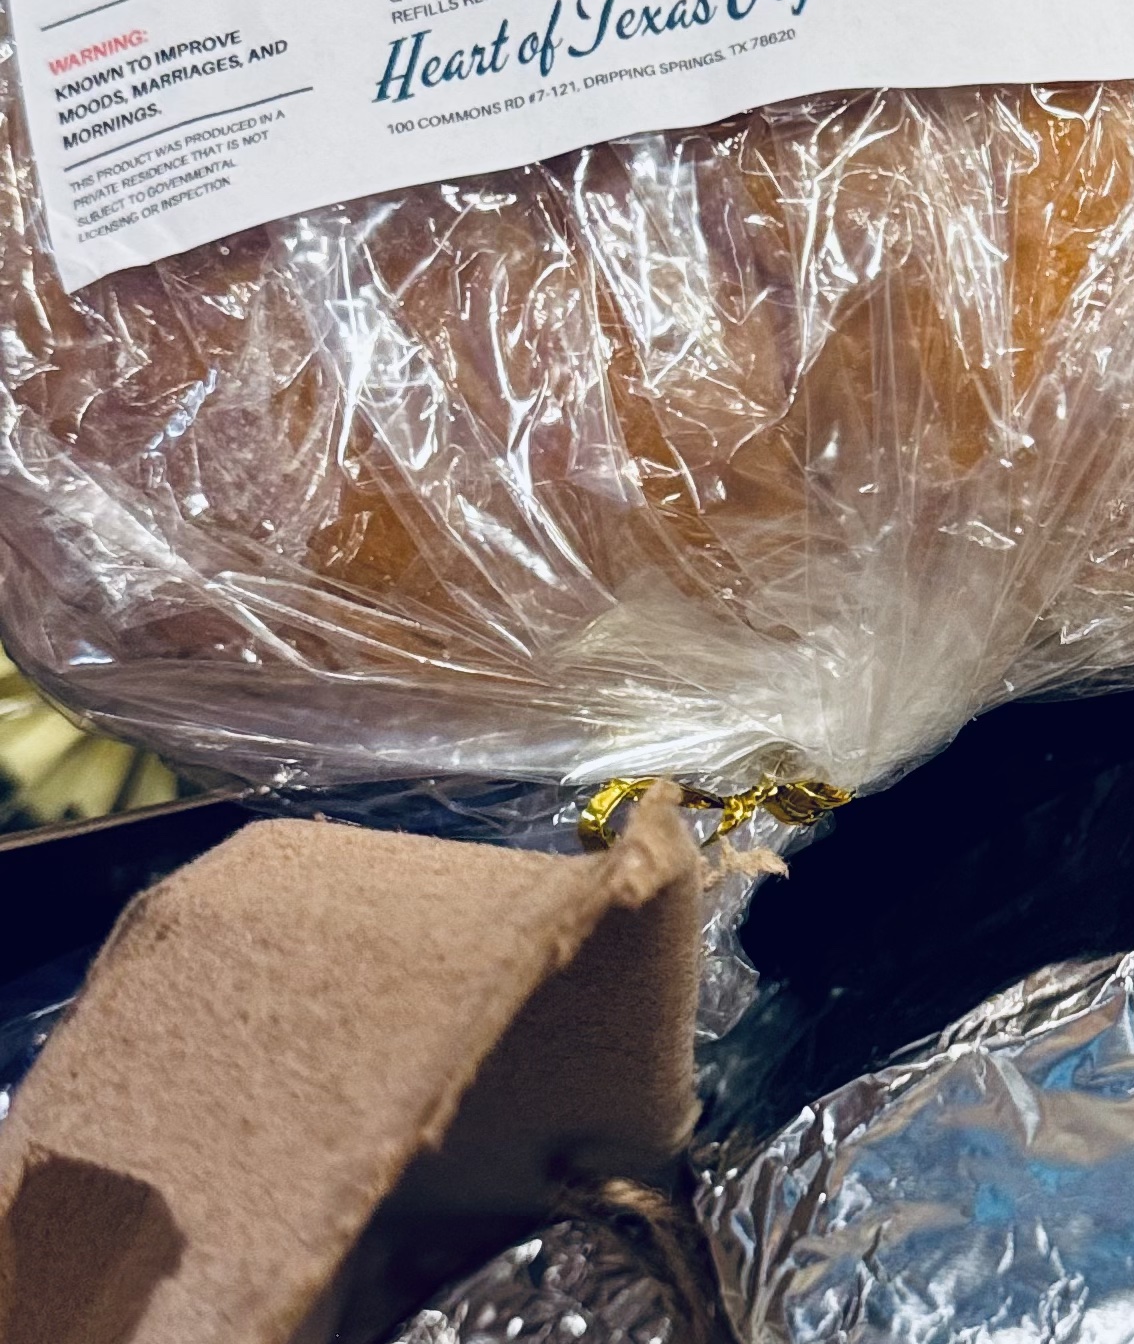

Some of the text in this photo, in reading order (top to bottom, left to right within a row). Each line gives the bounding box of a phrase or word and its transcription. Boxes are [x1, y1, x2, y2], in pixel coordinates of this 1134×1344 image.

[48, 29, 150, 76] WARNING:
[54, 30, 242, 102] KNOWN TO IMPROVE
[59, 40, 289, 126] MOODS, MARRIAGES, AND
[370, 20, 510, 105] Heart
[386, 118, 415, 136] 100
[417, 101, 502, 132] COMMONS
[504, 93, 526, 111] RD
[529, 81, 580, 107] #7-121,
[583, 63, 656, 91] DRIPPING
[728, 42, 750, 58] TX
[751, 28, 797, 51] 78620
[63, 103, 162, 151] MORNINGS.
[69, 110, 285, 193] THIS PRODUCT WAS PRODUCED IN A
[73, 130, 270, 211] PRIVATE RESIDENCE THAT IS NOT
[76, 199, 126, 229] SUBJECT
[128, 190, 145, 205] TO
[78, 176, 232, 244] LICENSING OR INSPECTION
